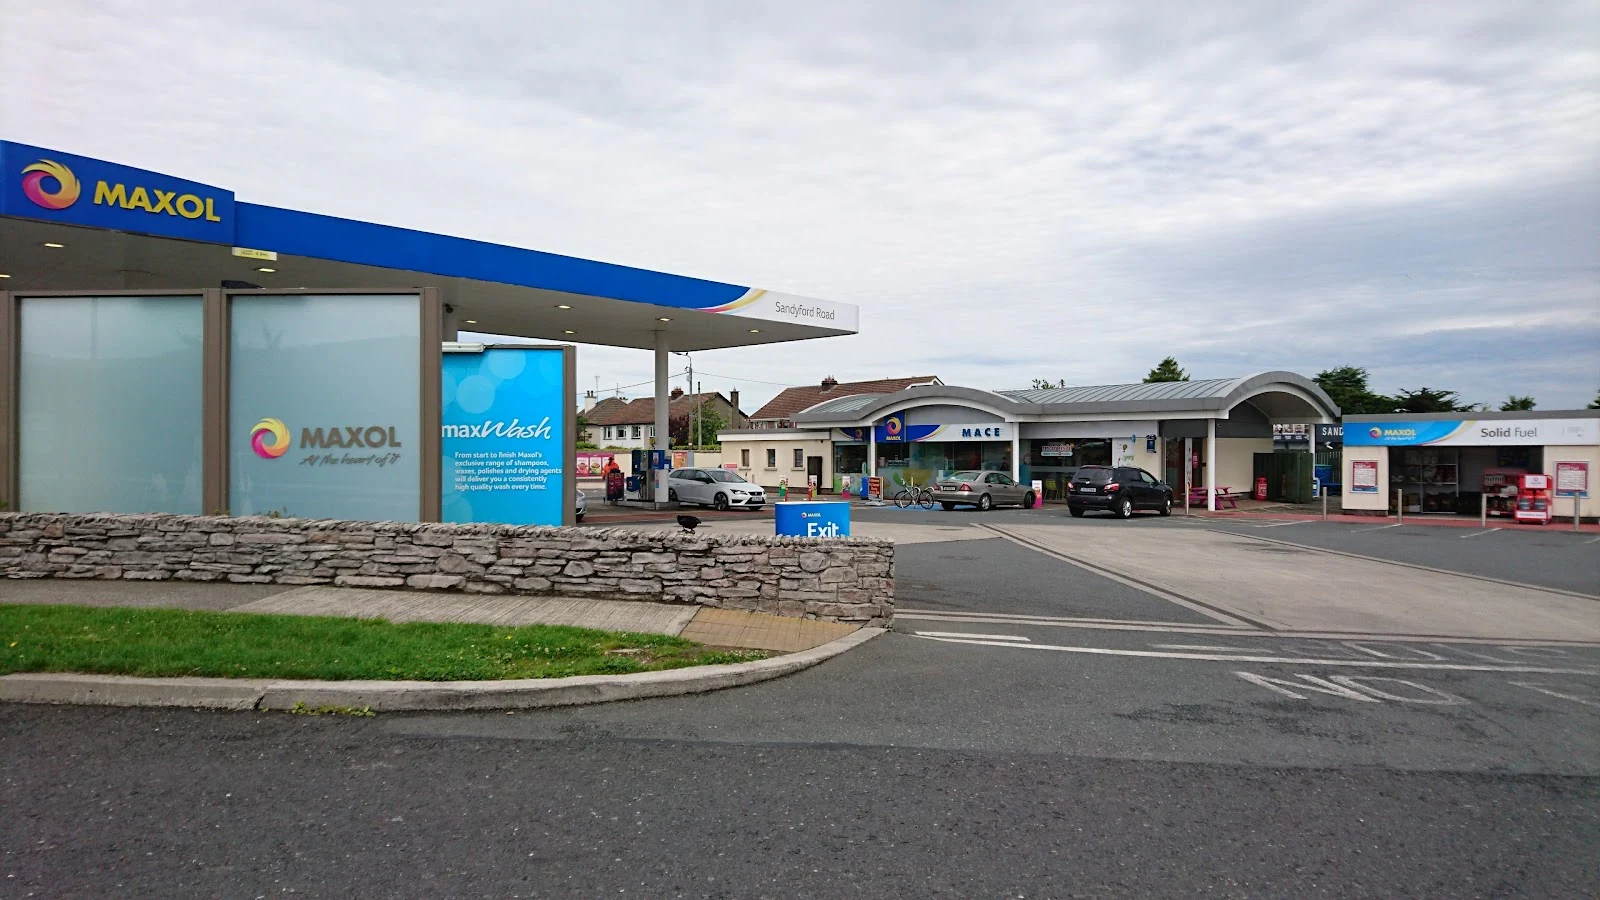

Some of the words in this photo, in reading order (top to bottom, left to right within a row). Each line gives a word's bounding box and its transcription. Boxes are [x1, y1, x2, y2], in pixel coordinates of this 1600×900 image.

[93, 181, 221, 222] MAXOL
[775, 301, 815, 318] Sandyford
[816, 307, 835, 320] Road
[441, 416, 552, 440] maxWash
[962, 427, 1000, 438] MACE
[1481, 427, 1511, 438] Solid
[1514, 427, 1538, 438] fuel
[300, 426, 402, 449] MAXOL
[320, 453, 340, 467] the
[340, 452, 376, 466] heart
[375, 452, 391, 467] of
[389, 452, 401, 465] it
[455, 451, 472, 459] From
[514, 459, 549, 468] shampoos,
[477, 468, 504, 476] polishes
[505, 467, 518, 475] and
[518, 467, 540, 476] drying
[540, 468, 562, 476] agents
[490, 476, 502, 484] you
[508, 475, 548, 484] consistently
[455, 483, 470, 492] high
[470, 483, 493, 492] quality
[511, 484, 530, 492] every
[807, 521, 840, 537] Exit
[1233, 671, 1472, 705] NO
